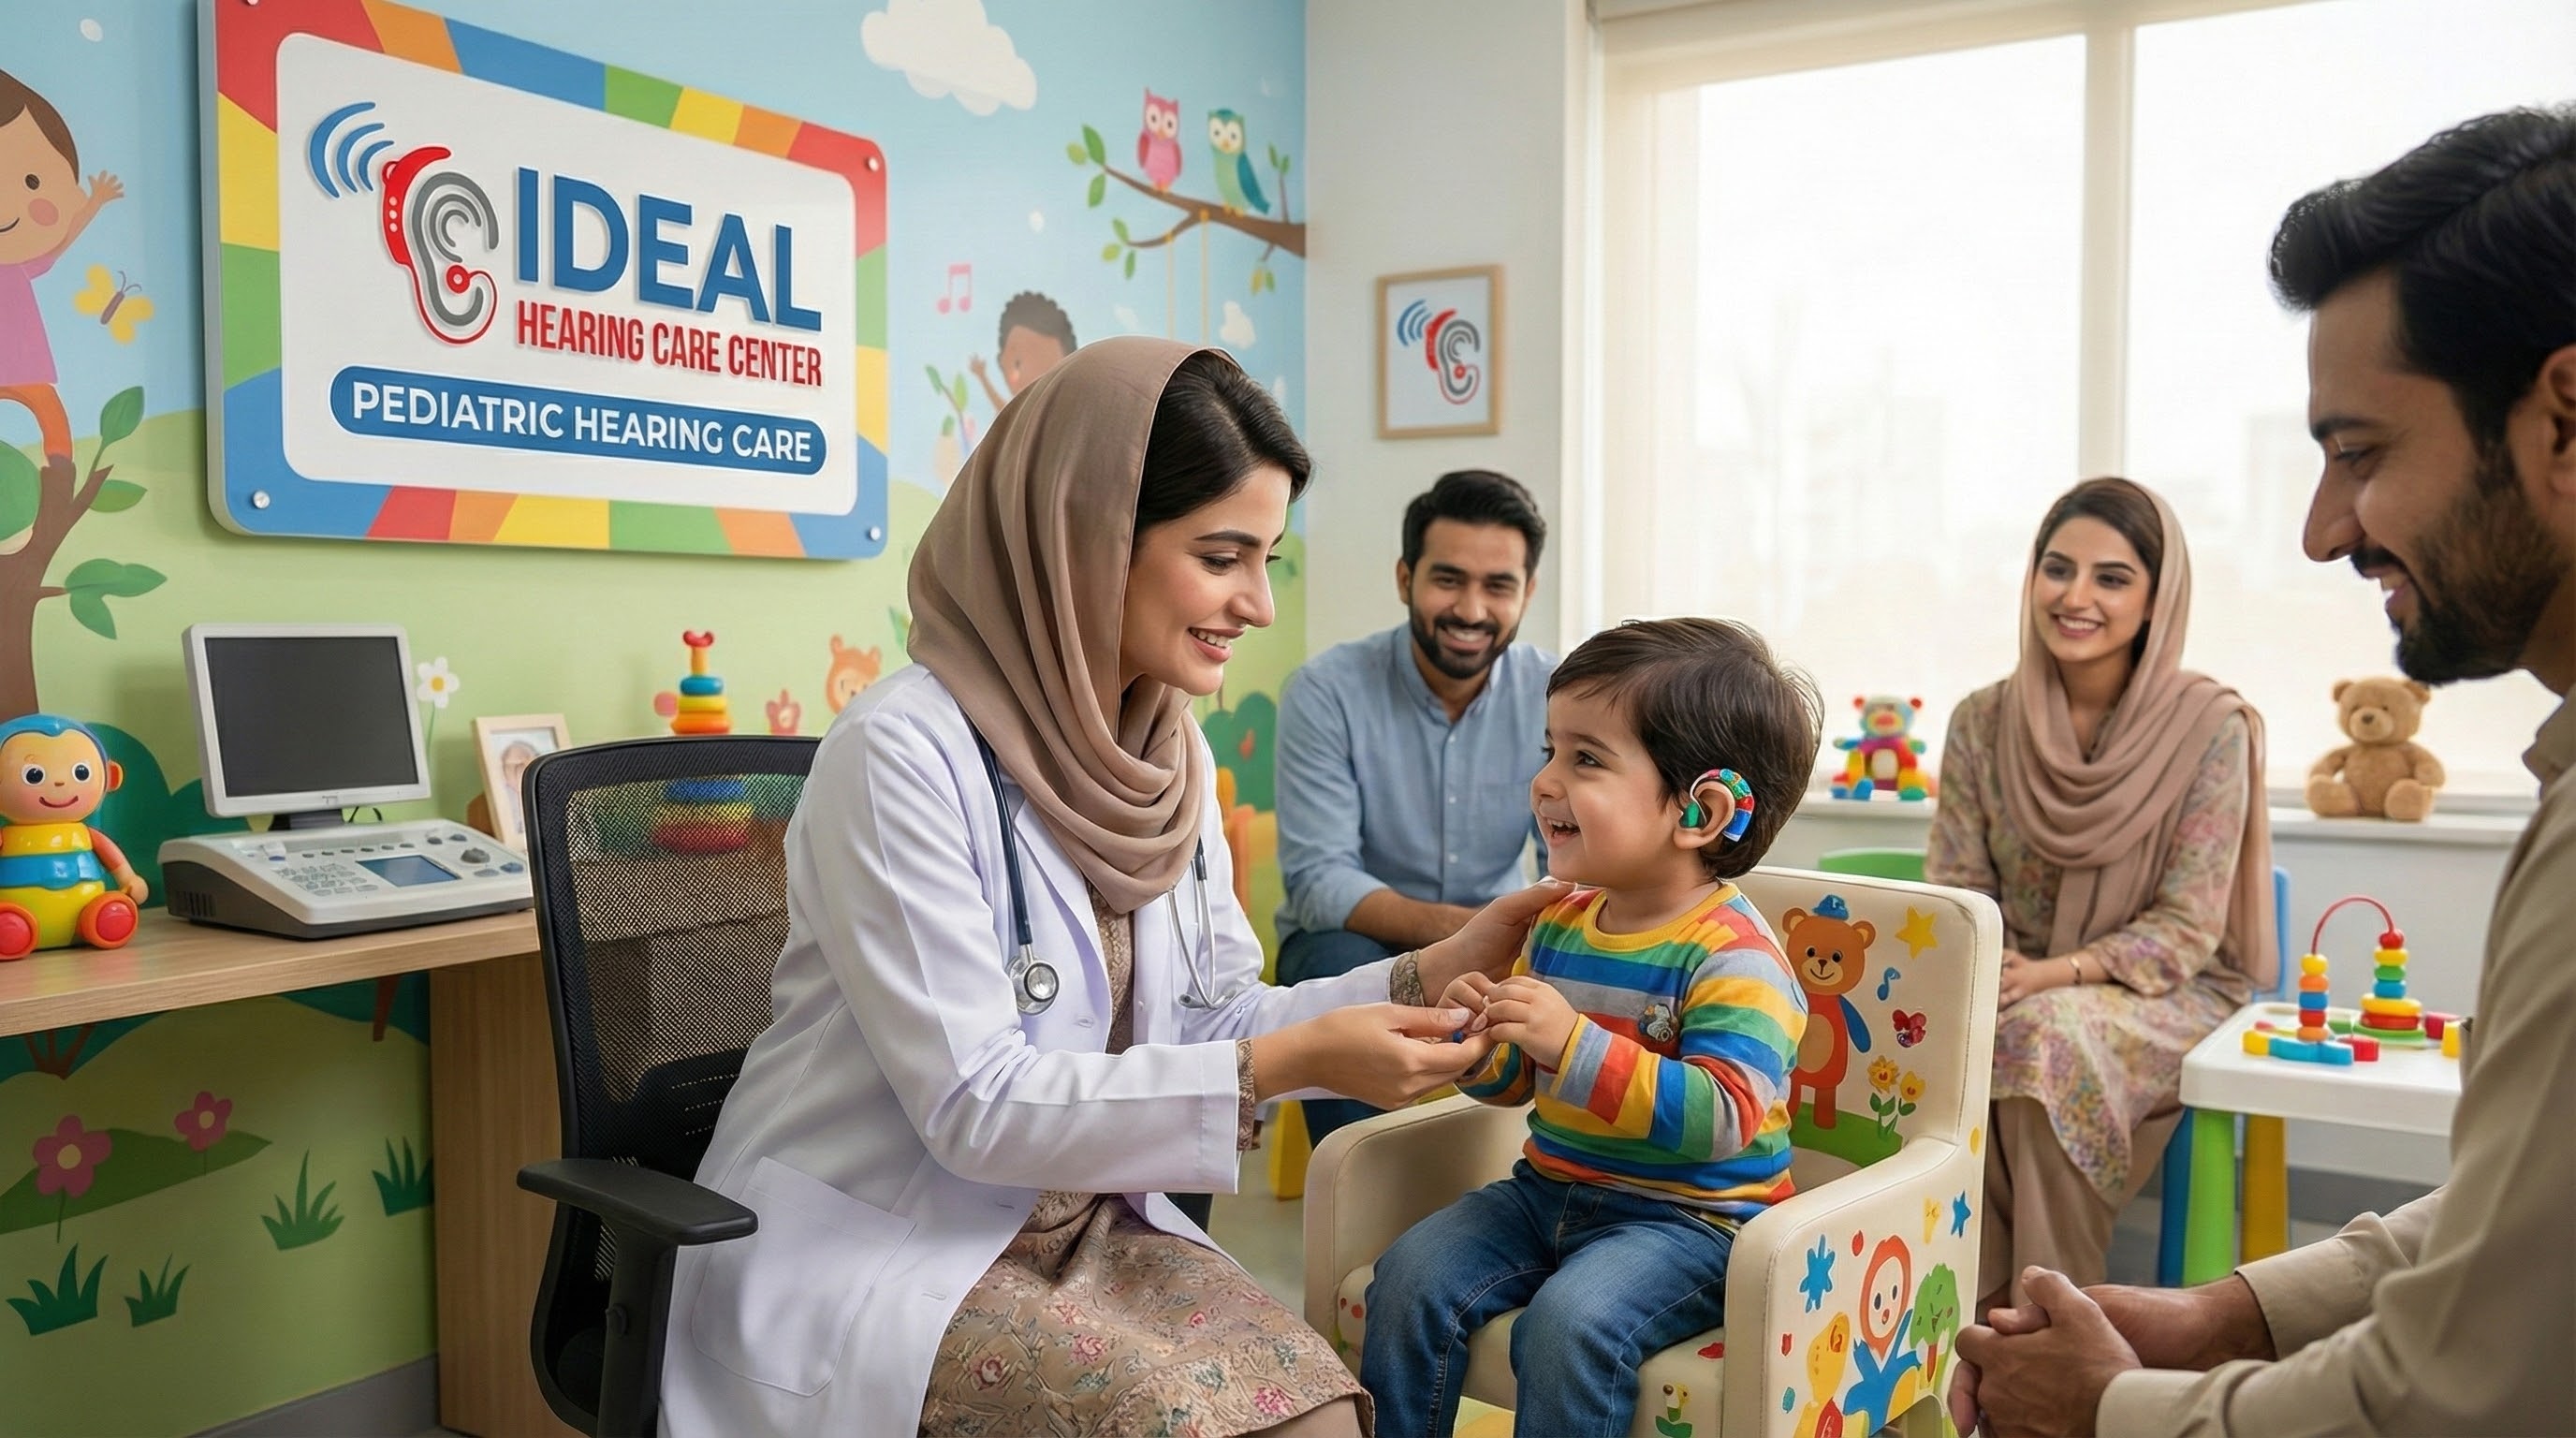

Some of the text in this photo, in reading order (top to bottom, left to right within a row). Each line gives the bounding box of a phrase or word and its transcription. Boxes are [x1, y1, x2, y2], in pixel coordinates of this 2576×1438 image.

[517, 167, 823, 331] IDEAL
[517, 300, 823, 387] HEARING CARE CENTER
[352, 380, 812, 463] PEDIATRIC HEARING CARE
